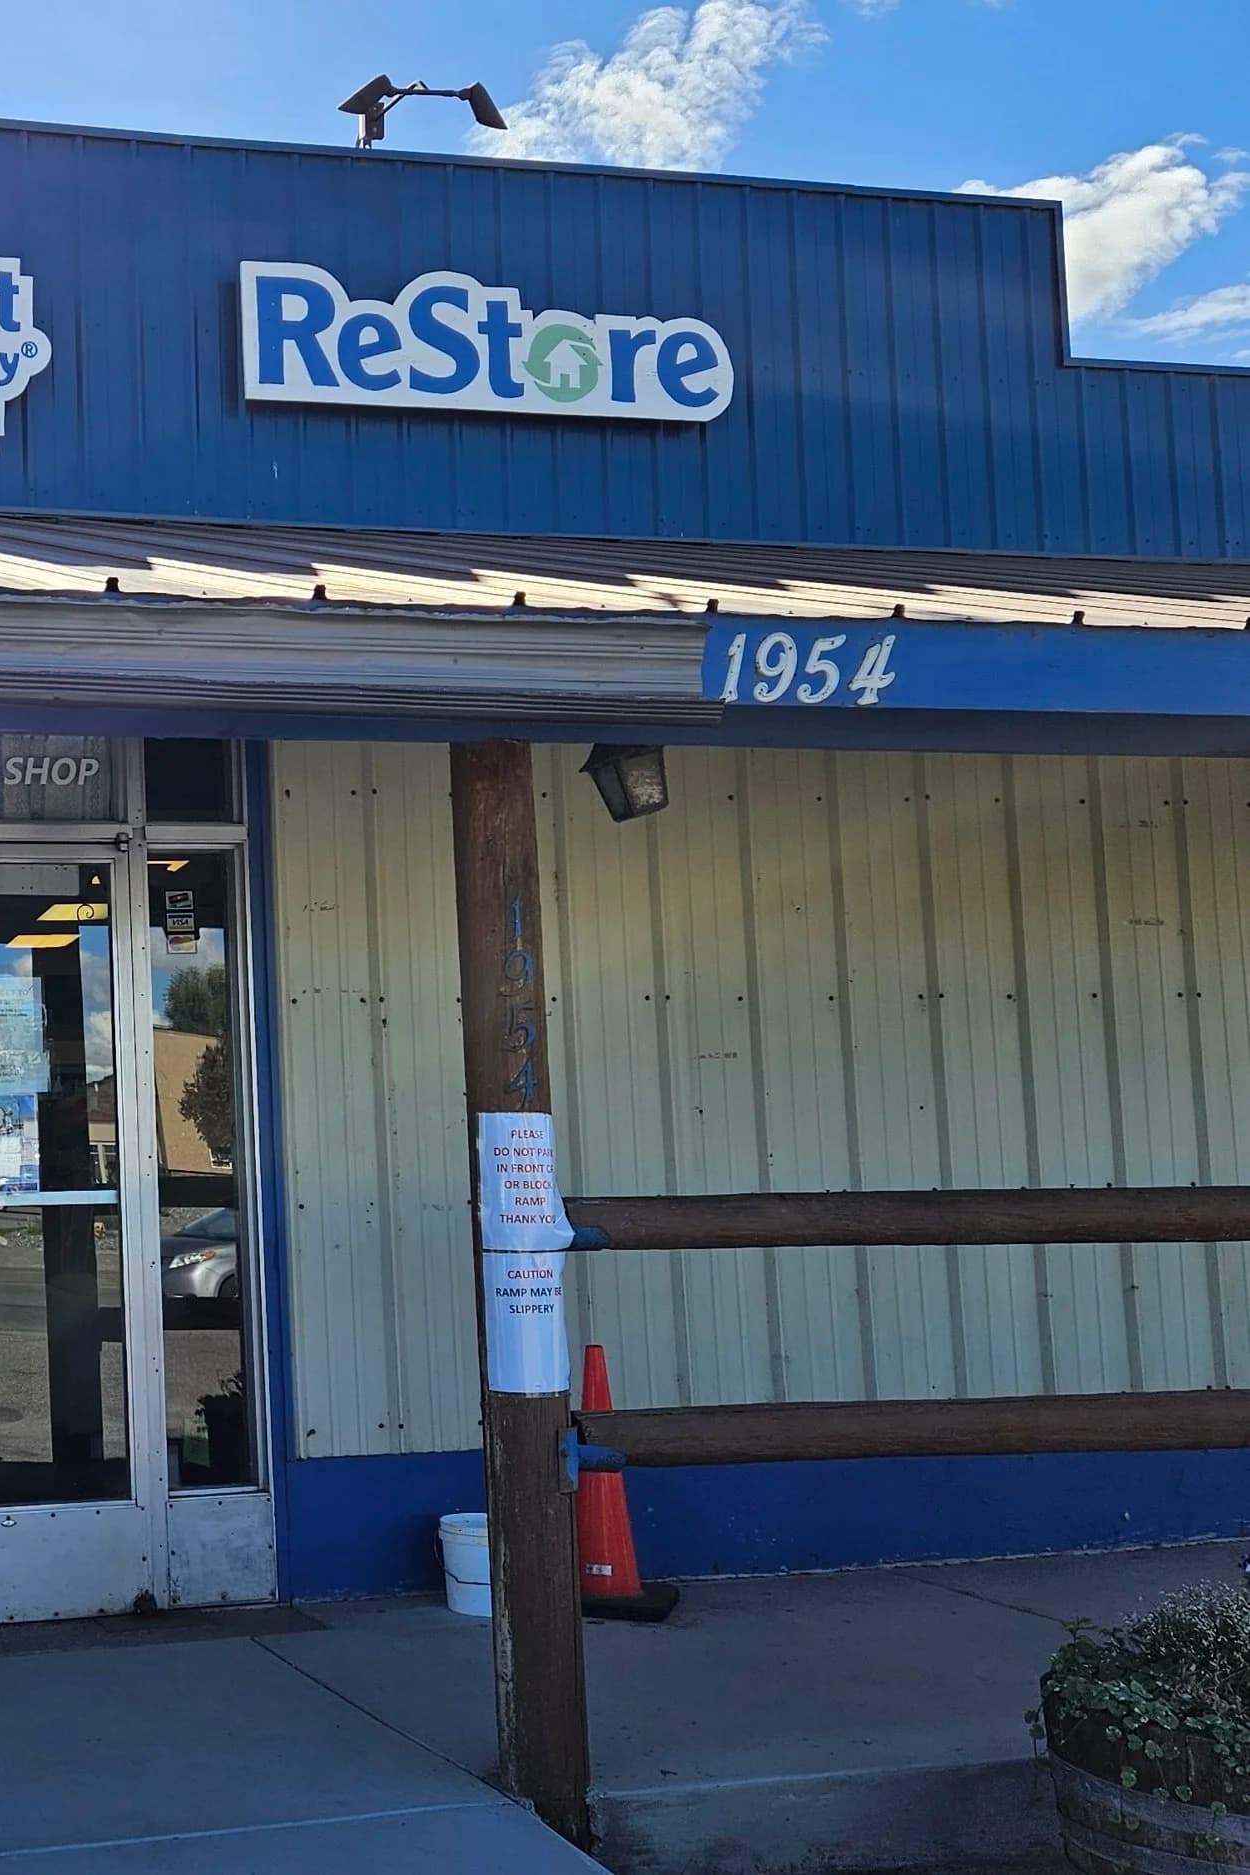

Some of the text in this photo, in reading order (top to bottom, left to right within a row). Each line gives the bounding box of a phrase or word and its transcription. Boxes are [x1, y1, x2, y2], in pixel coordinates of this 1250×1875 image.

[255, 275, 720, 408] ReStore
[719, 631, 896, 706] 1954
[4, 756, 100, 786] SHOP
[500, 895, 537, 1109] 1954
[510, 1129, 544, 1139] PLEASE
[493, 1147, 510, 1157] DO
[513, 1147, 536, 1157] NOT
[496, 1163, 508, 1173] IN
[511, 1163, 544, 1174] FRONT
[504, 1180, 520, 1190] OR
[515, 1196, 546, 1207] RAMP
[500, 1214, 538, 1225] THANK
[507, 1269, 554, 1279] CAUTION
[495, 1287, 527, 1297] RAMP
[530, 1287, 553, 1297] MAY
[509, 1303, 555, 1314] SLIPPERY
